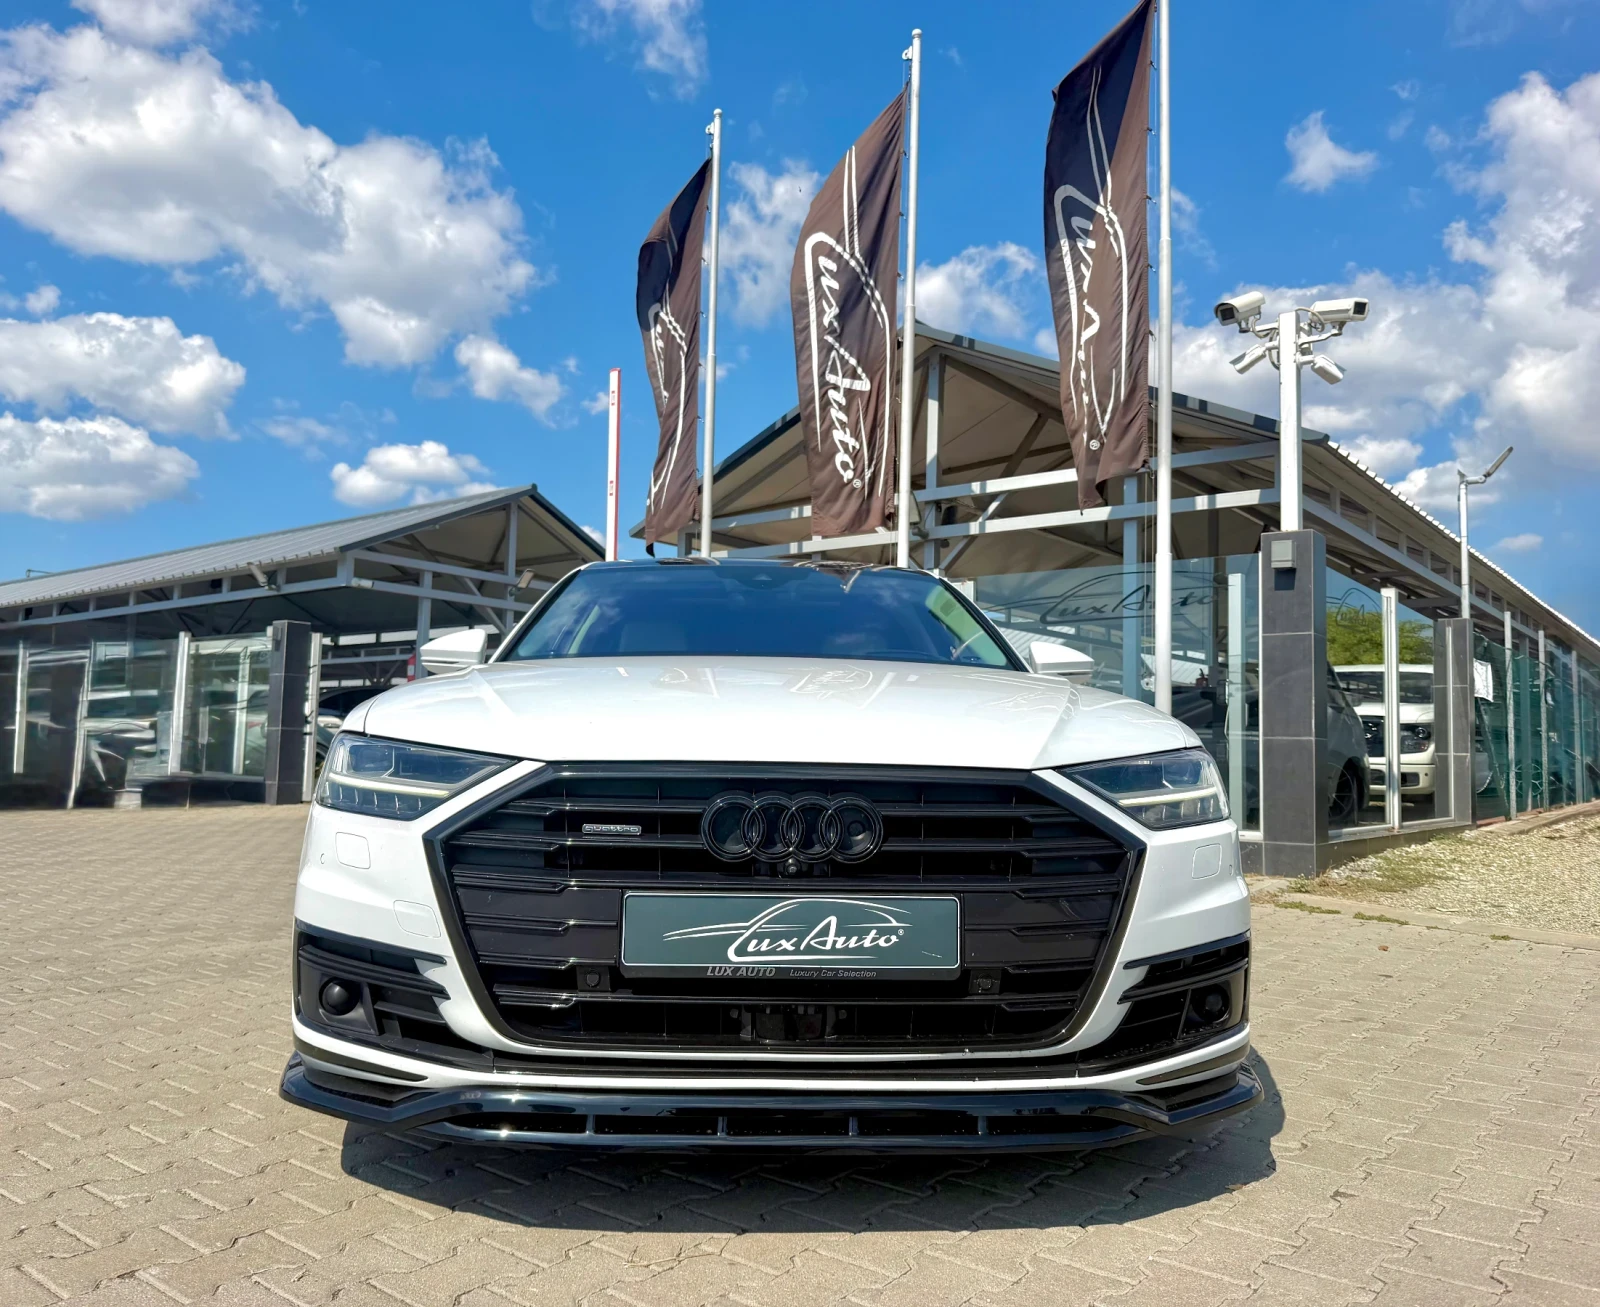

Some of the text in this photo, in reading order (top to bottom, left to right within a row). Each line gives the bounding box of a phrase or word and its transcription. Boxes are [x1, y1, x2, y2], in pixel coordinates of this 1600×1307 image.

[1040, 594, 1108, 625] Lux
[727, 920, 799, 962] Lux
[706, 965, 877, 979] LUX AUTO Luxury Car Selection
